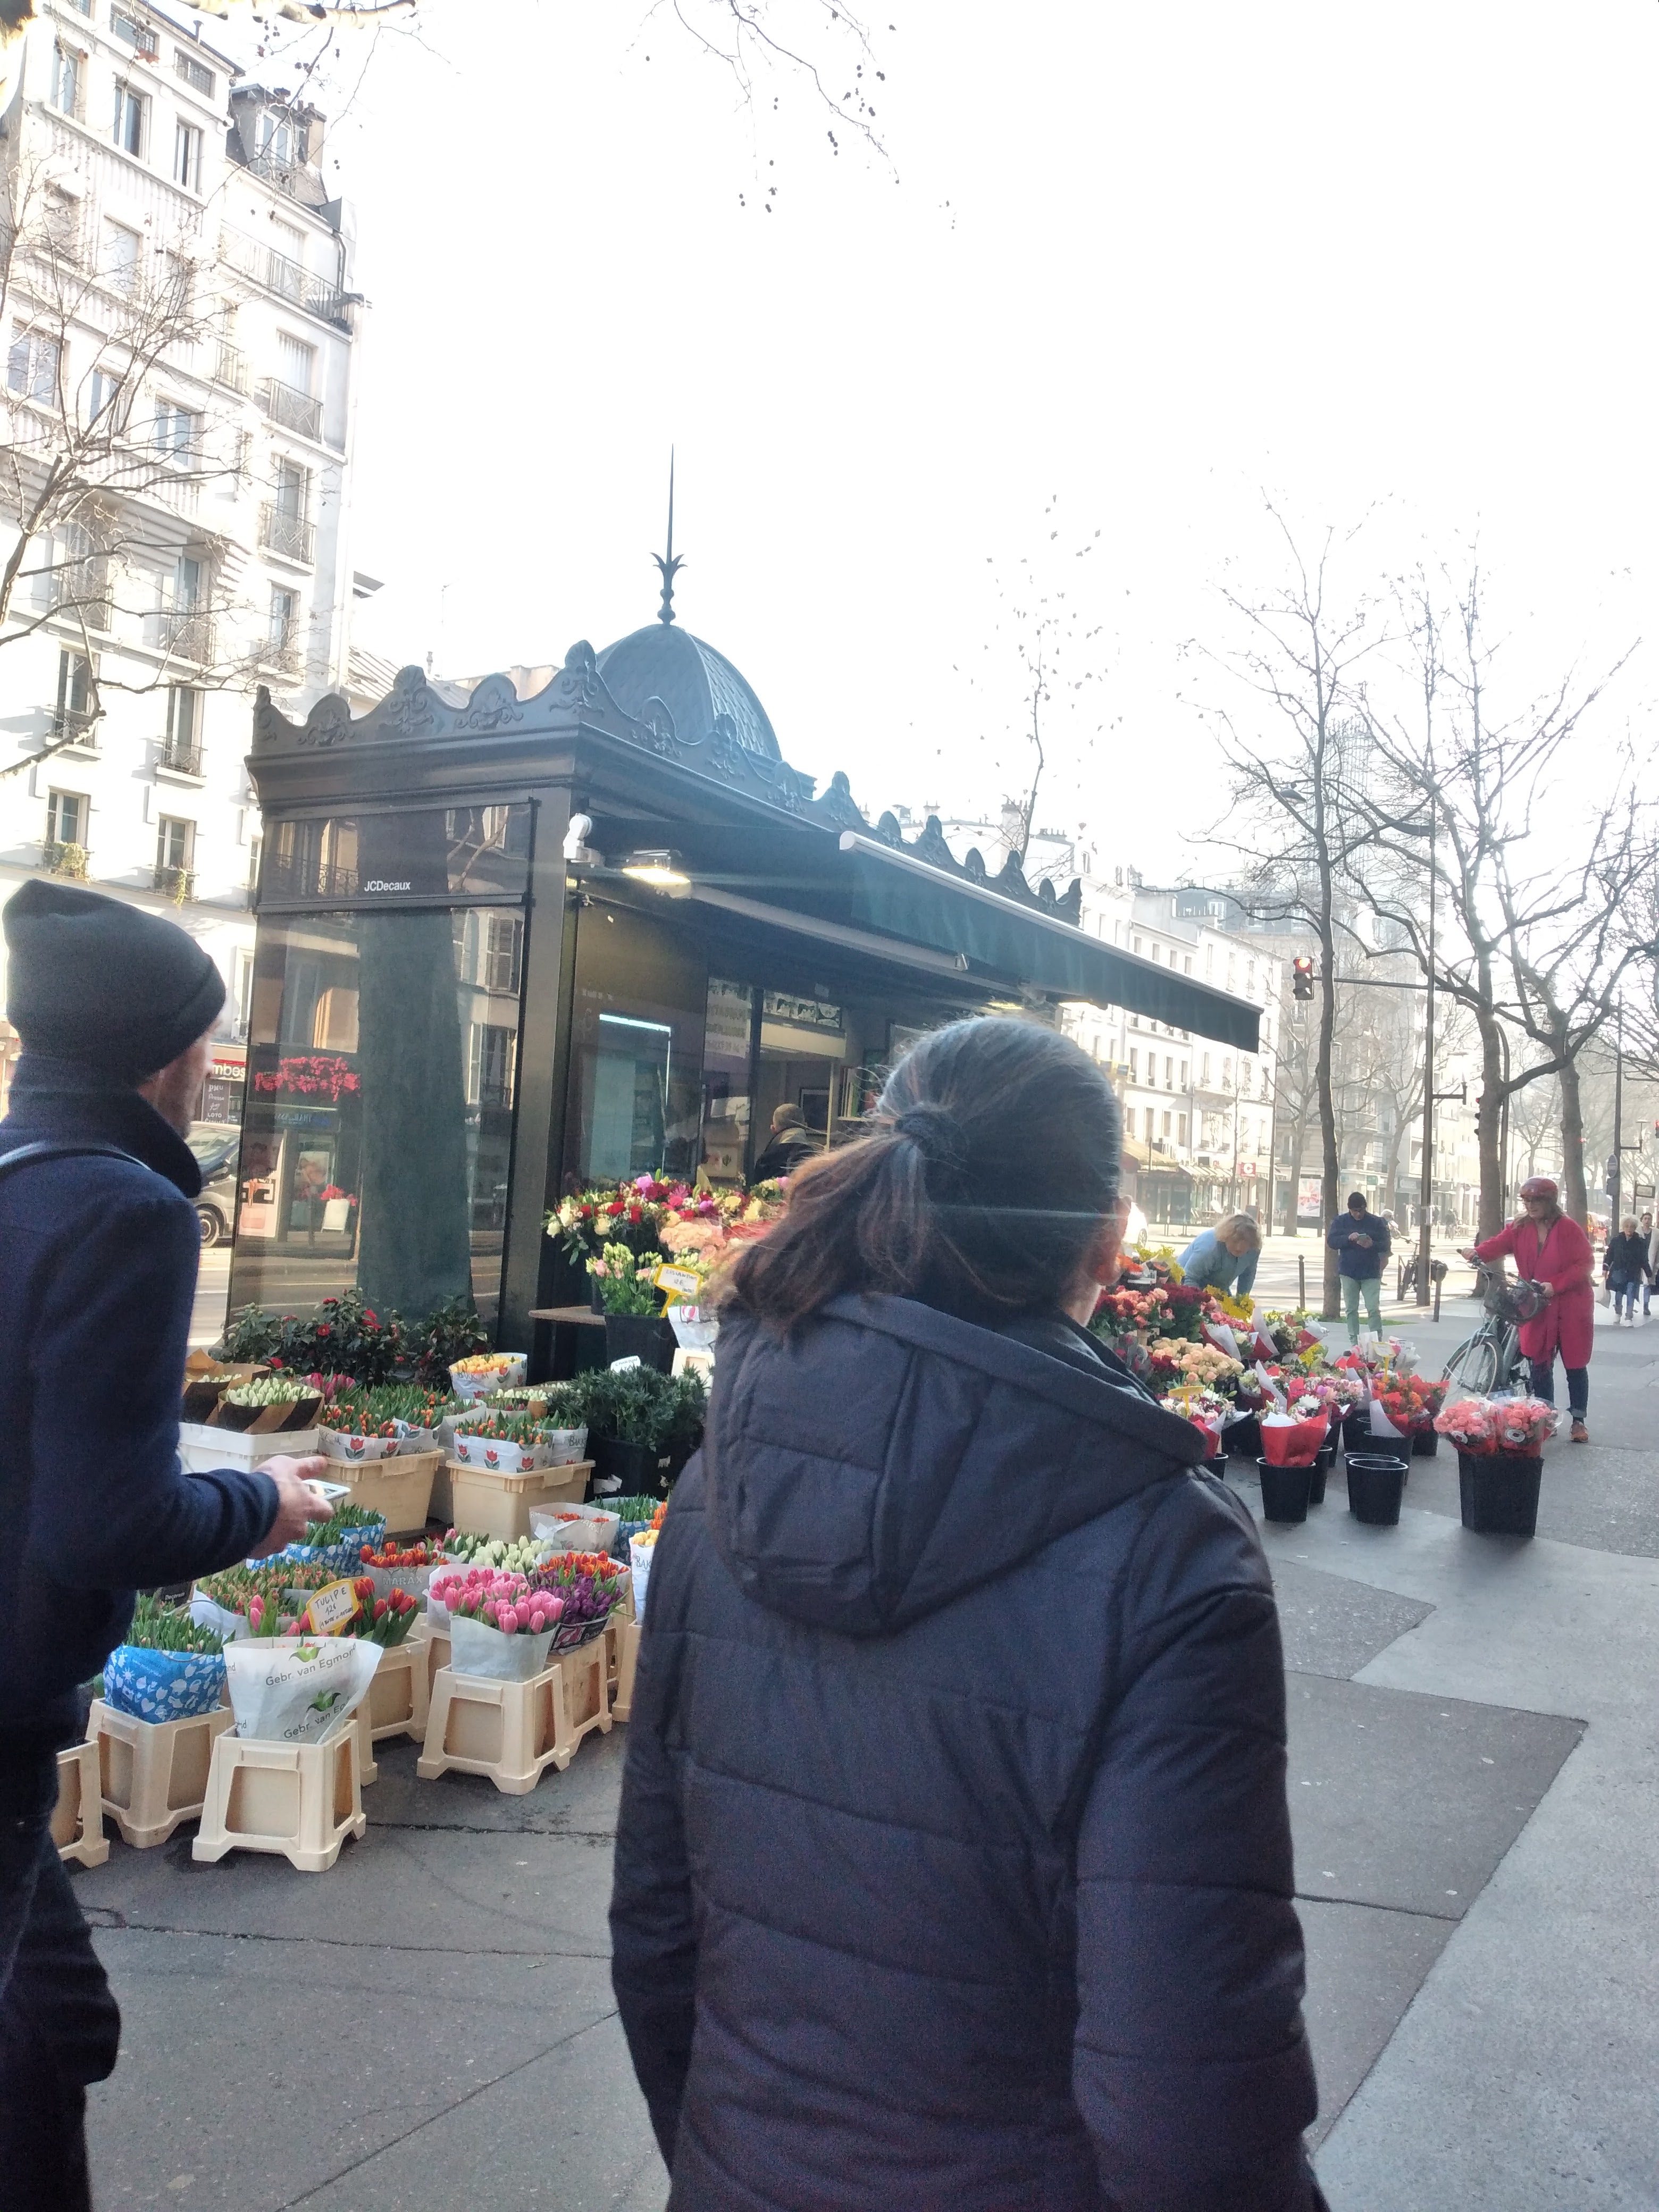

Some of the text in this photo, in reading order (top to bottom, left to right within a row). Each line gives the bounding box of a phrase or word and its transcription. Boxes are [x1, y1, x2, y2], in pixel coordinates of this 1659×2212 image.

[364, 880, 410, 892] JCDecaux
[383, 1576, 423, 1585] MARAX
[315, 1587, 347, 1609] TULIPE
[297, 1665, 316, 1677] van
[319, 1642, 357, 1669] Egmond
[315, 1712, 331, 1725] van
